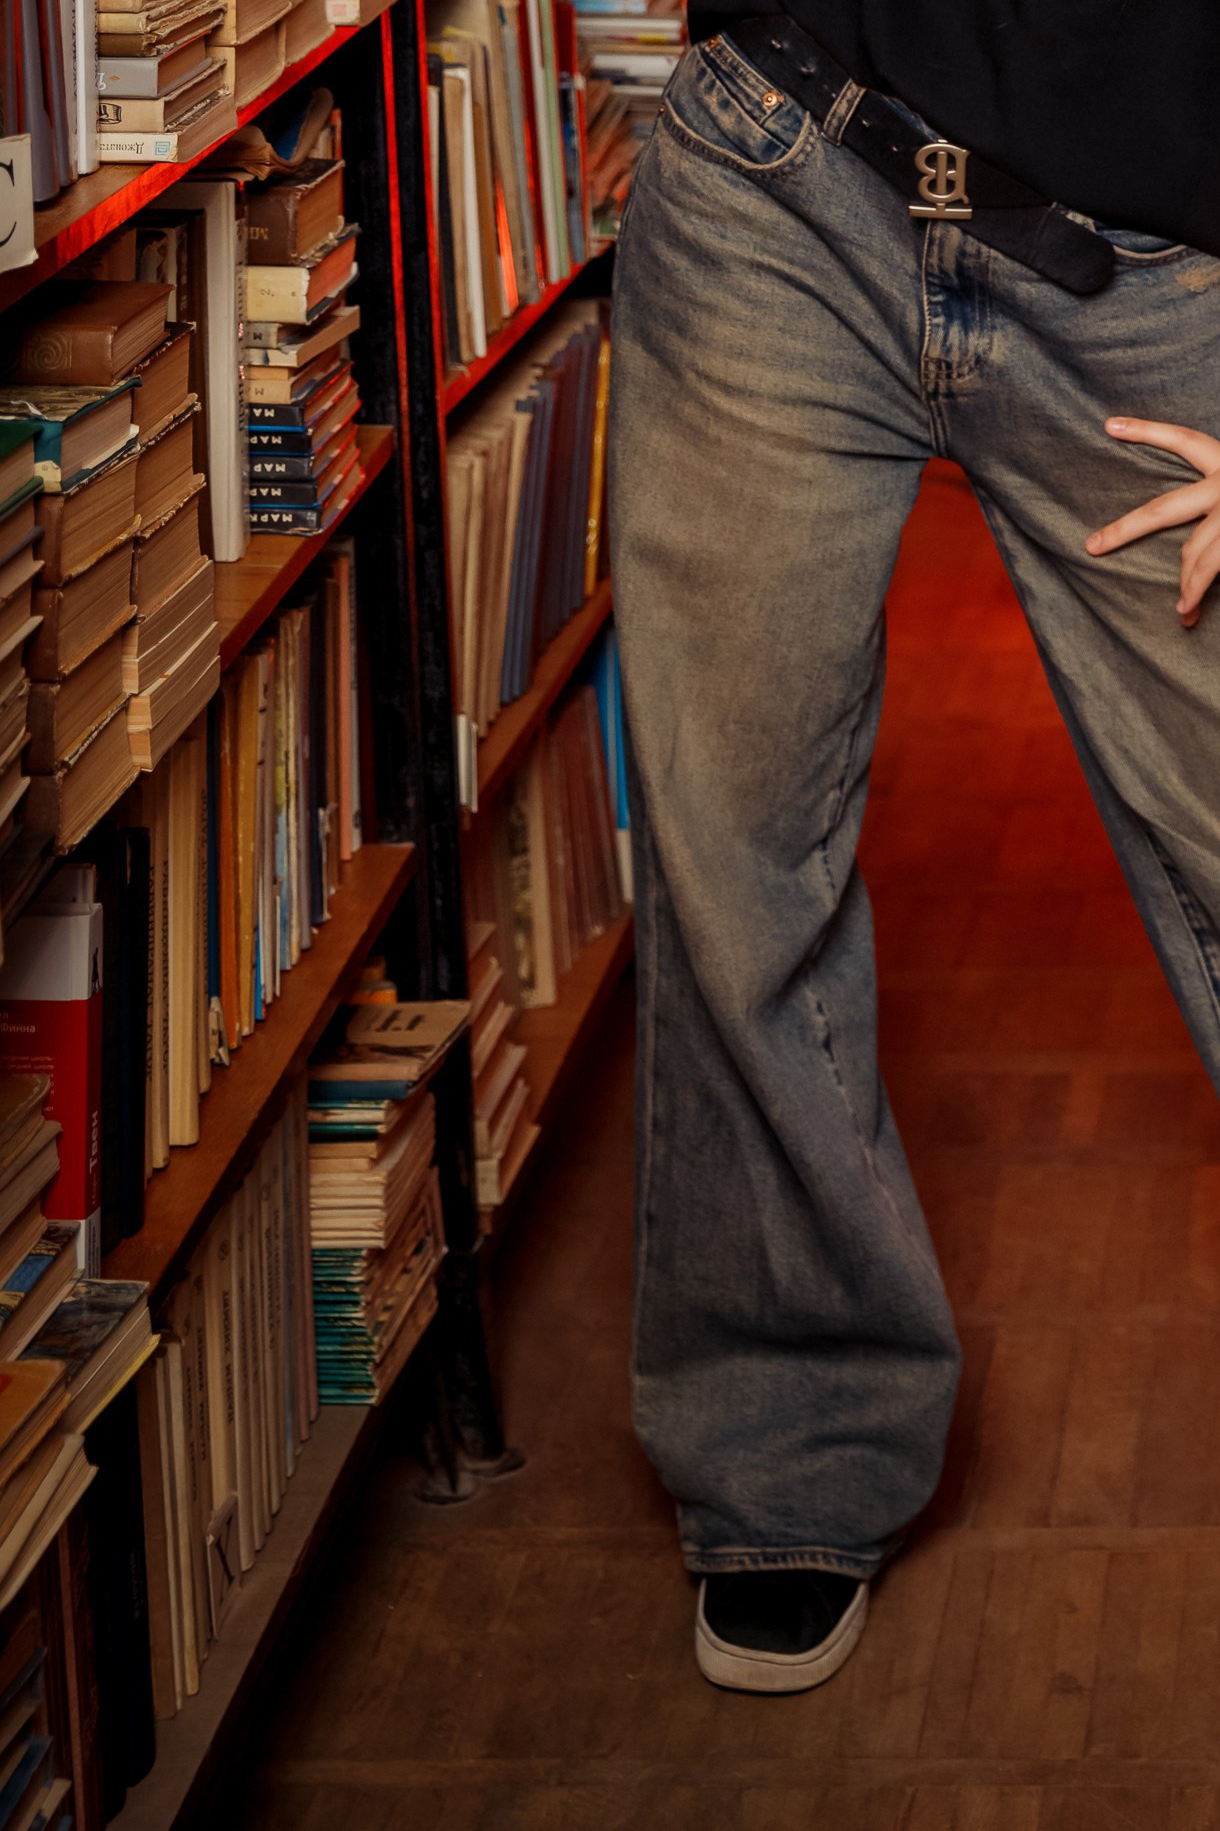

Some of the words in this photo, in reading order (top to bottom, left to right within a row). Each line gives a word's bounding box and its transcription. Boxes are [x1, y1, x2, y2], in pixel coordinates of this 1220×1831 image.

[99, 141, 145, 155] Джоната
[252, 408, 275, 418] МА
[249, 435, 282, 445] МАР
[252, 462, 286, 473] МАР
[249, 487, 282, 497] МАР
[88, 1110, 99, 1174] Твен
